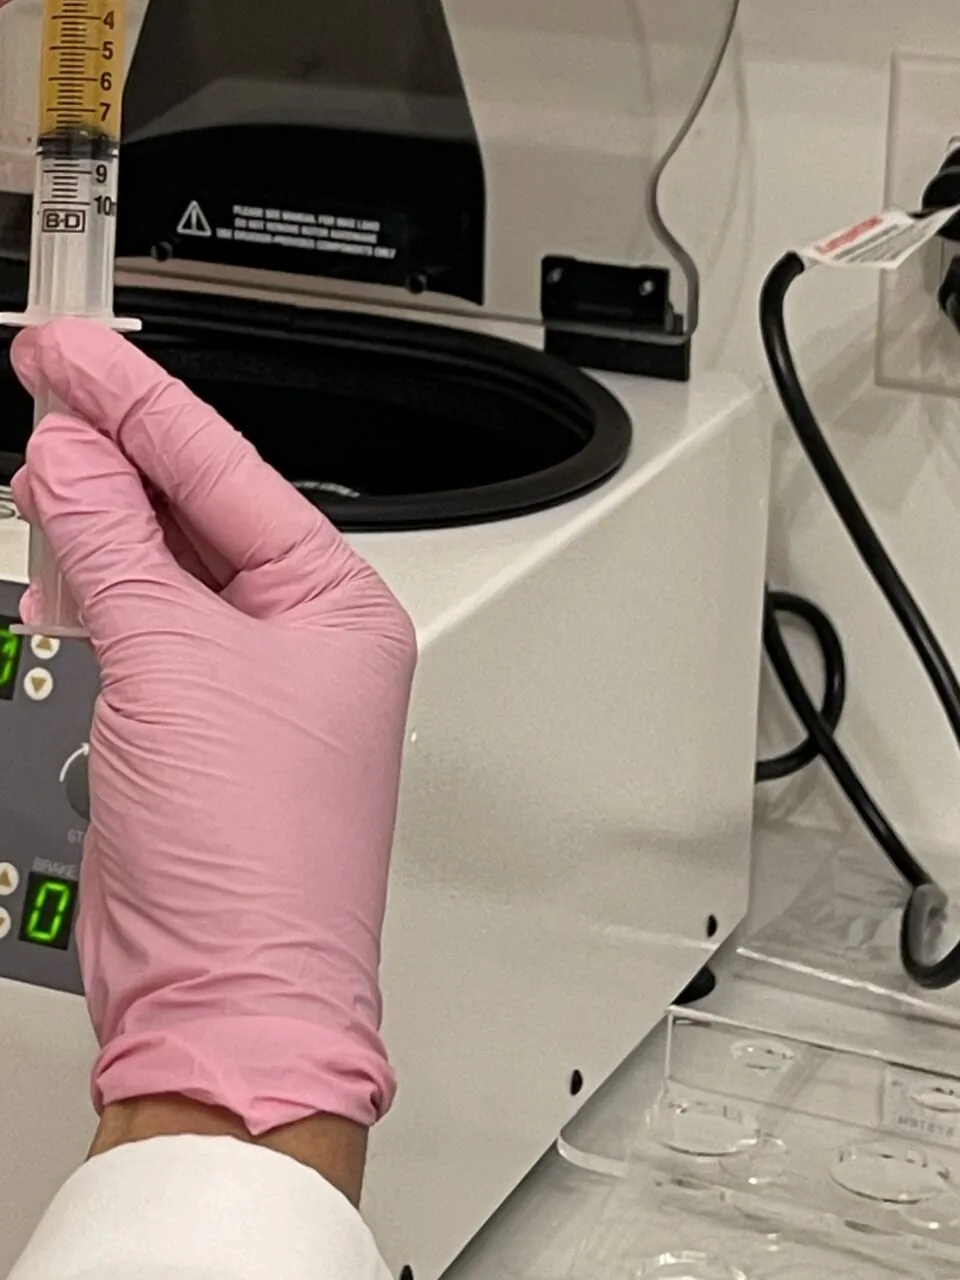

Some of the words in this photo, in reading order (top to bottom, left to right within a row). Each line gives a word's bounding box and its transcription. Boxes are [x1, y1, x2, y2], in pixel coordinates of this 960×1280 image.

[103, 10, 115, 30] 4
[102, 41, 114, 60] 5
[100, 71, 112, 91] 6
[99, 102, 111, 122] 7
[95, 164, 108, 184] 9
[94, 195, 112, 216] 10
[27, 881, 70, 941] 0
